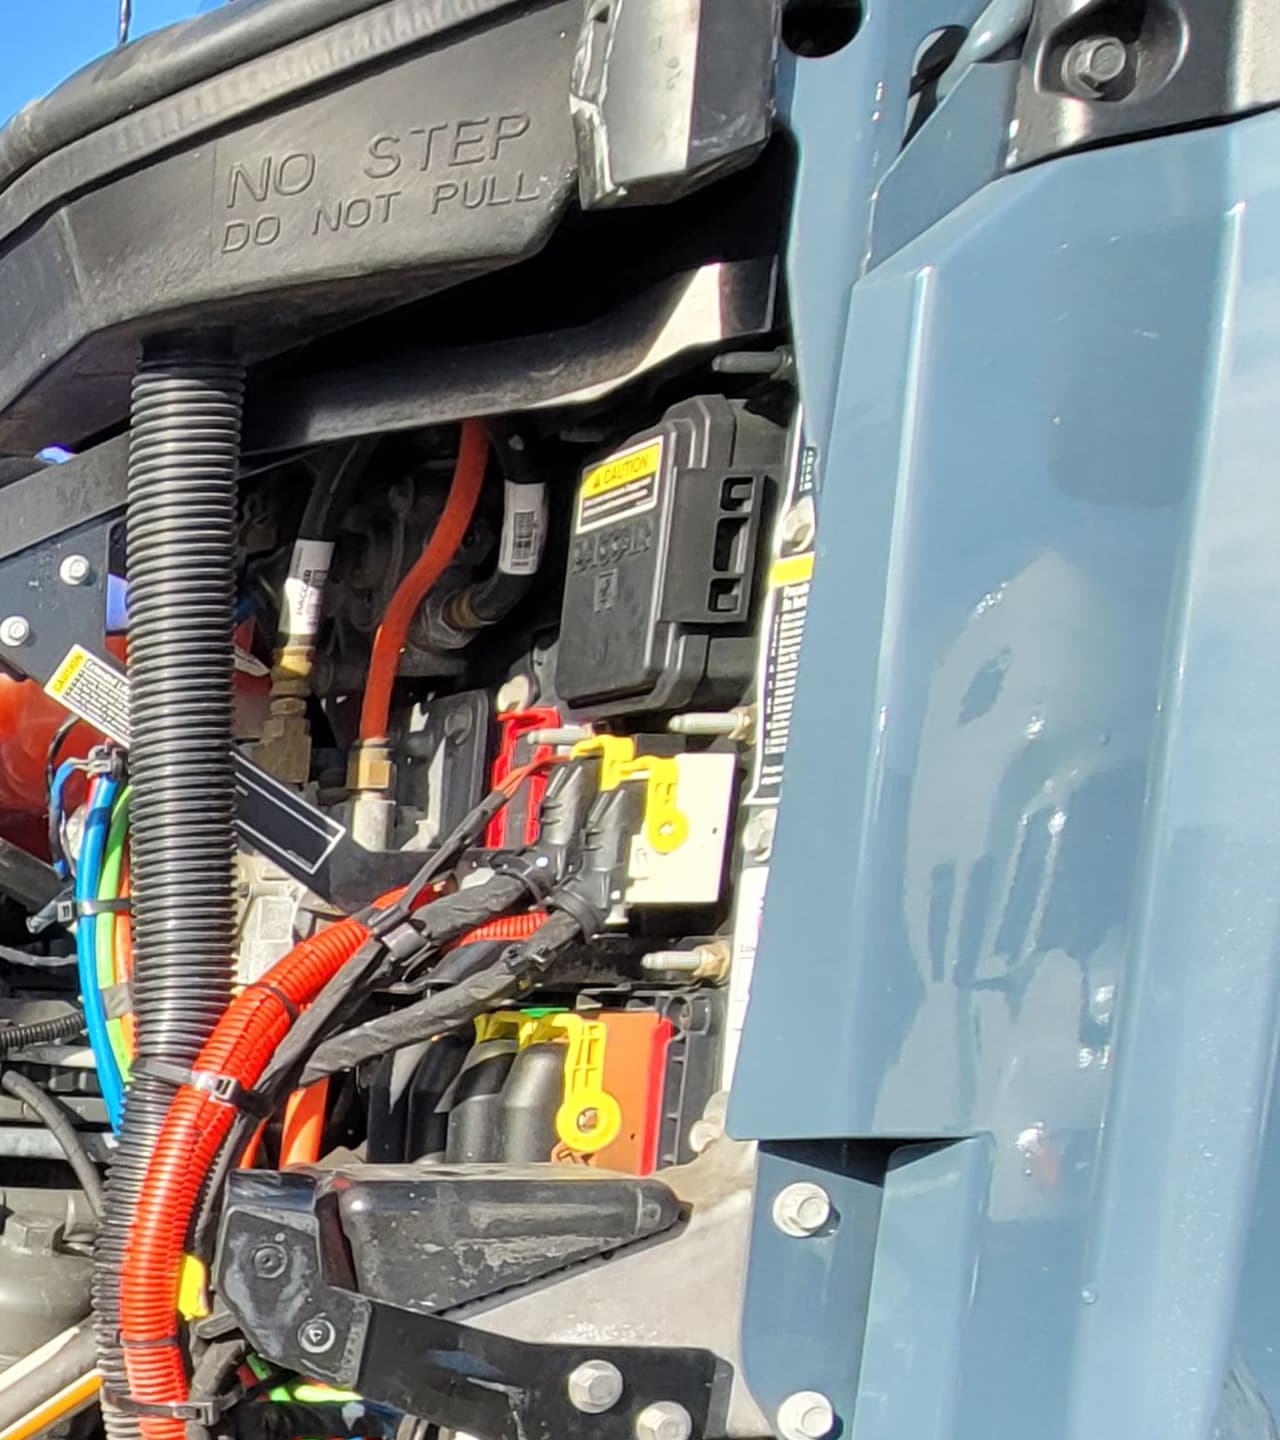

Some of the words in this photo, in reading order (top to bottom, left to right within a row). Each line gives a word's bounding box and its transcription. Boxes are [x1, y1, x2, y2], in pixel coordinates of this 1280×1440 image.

[226, 152, 316, 209] NO
[363, 112, 531, 179] STEP
[220, 216, 281, 254] DO
[312, 191, 401, 236] NOT
[430, 170, 540, 215] PULL
[604, 457, 648, 485] CAUTION
